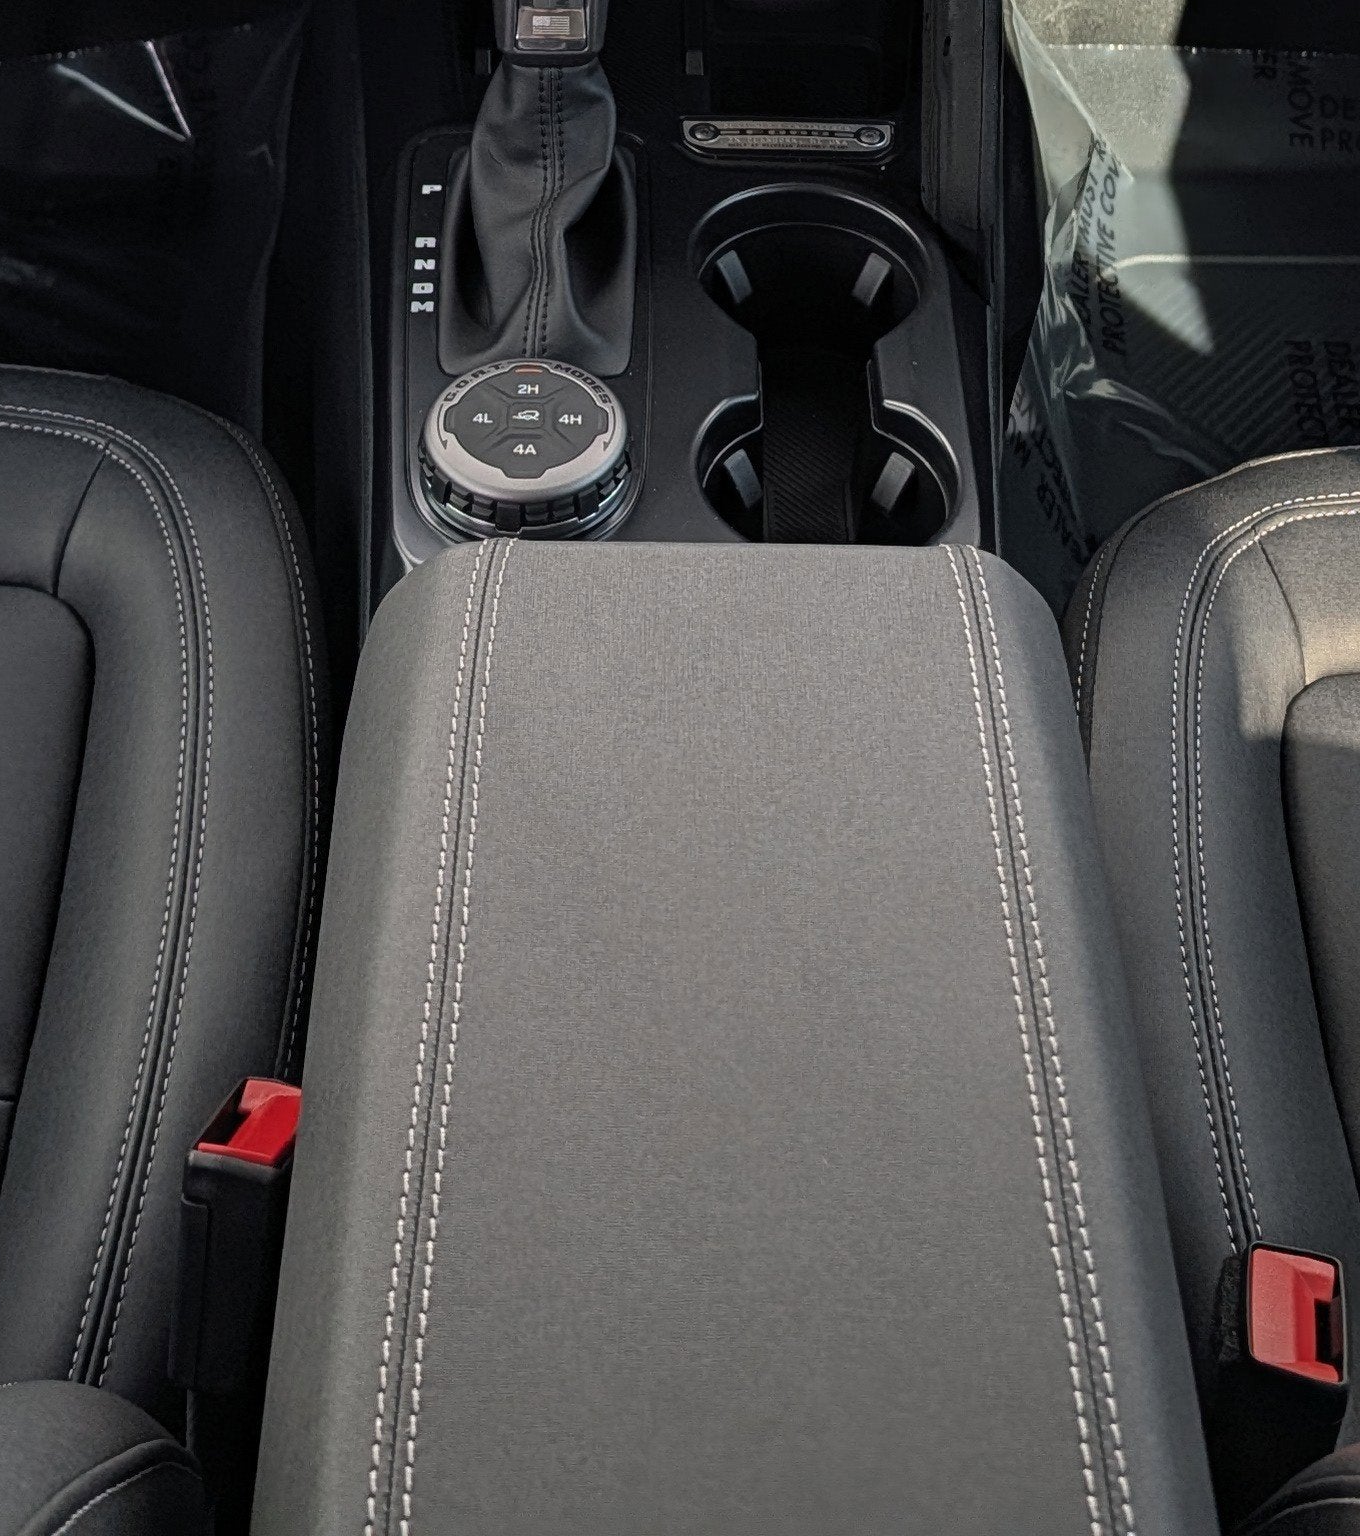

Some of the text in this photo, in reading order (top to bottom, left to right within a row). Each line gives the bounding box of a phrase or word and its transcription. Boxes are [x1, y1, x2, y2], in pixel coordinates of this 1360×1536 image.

[421, 184, 442, 195] P
[414, 258, 436, 270] N
[410, 301, 435, 313] M
[517, 384, 539, 395] 2H
[552, 363, 613, 405] MODES
[472, 413, 493, 424] 4L
[558, 414, 582, 425] 4H
[512, 443, 537, 455] 4A
